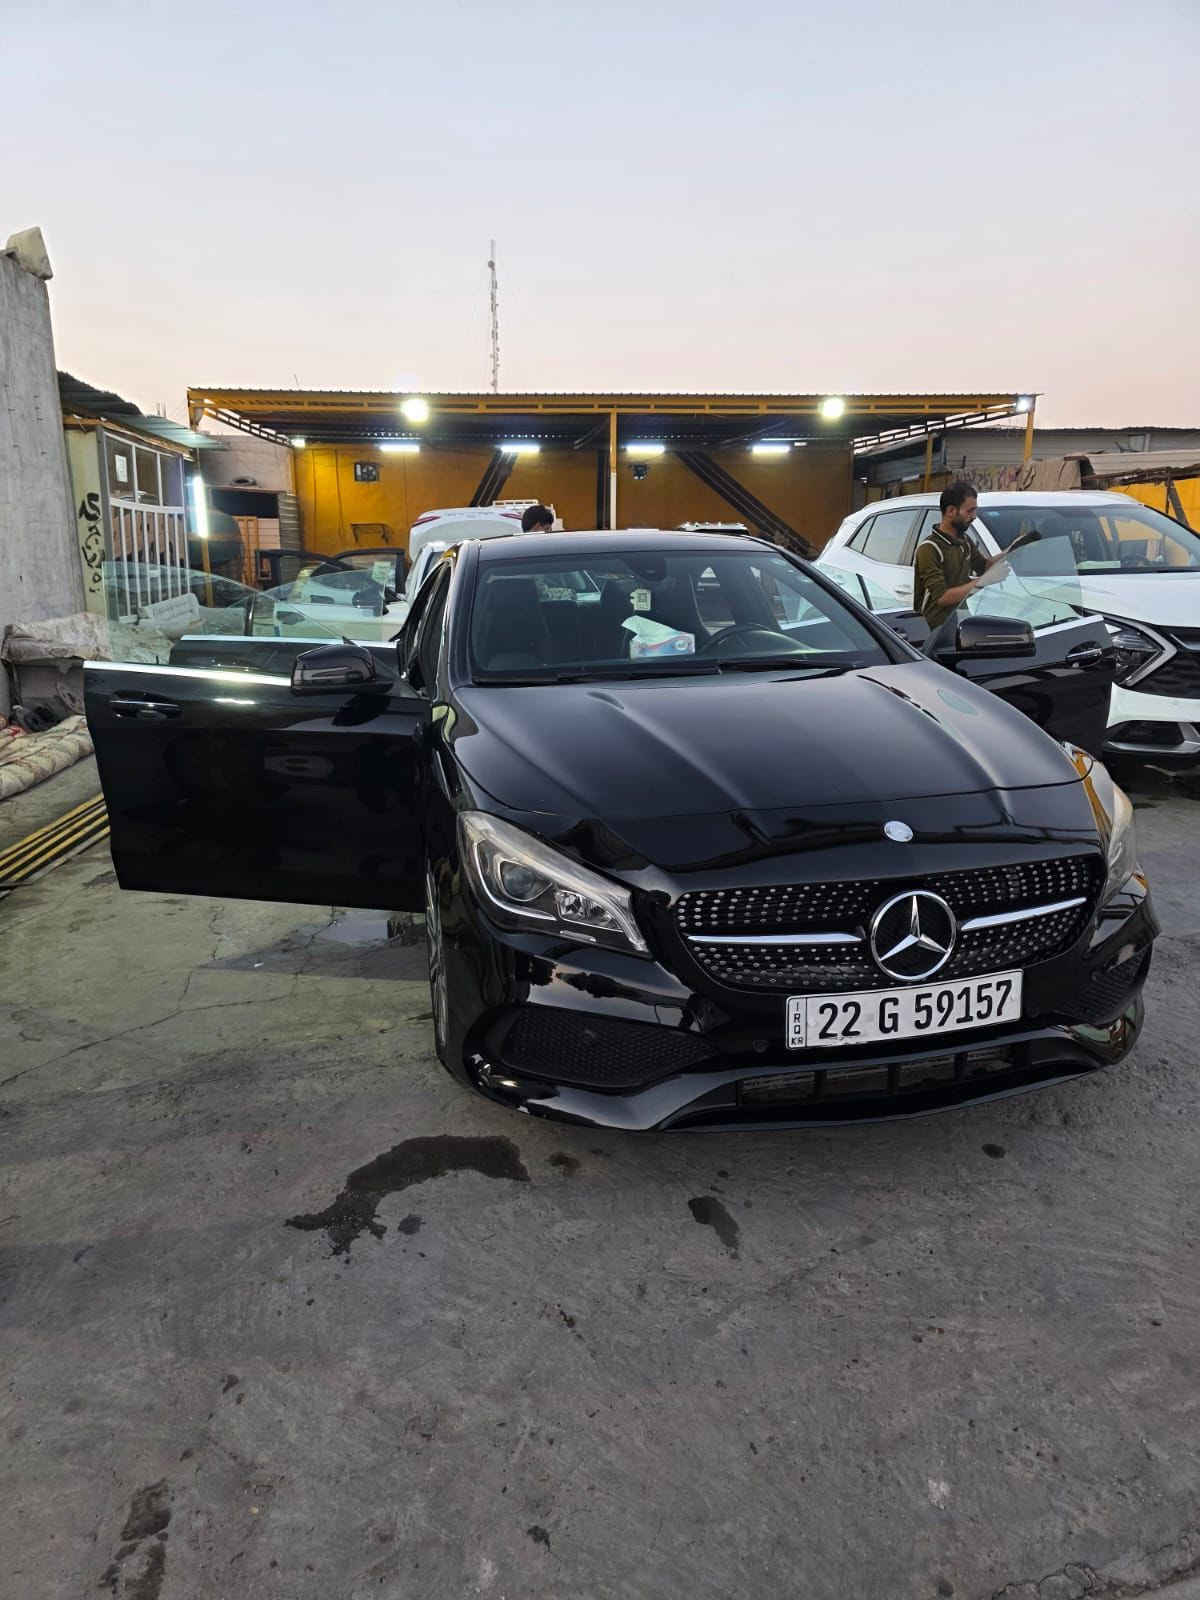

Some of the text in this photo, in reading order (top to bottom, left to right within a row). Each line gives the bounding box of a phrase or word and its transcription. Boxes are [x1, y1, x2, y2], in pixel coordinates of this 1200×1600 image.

[793, 1001, 801, 1034] IRQ
[818, 979, 1013, 1040] 22 G 59157
